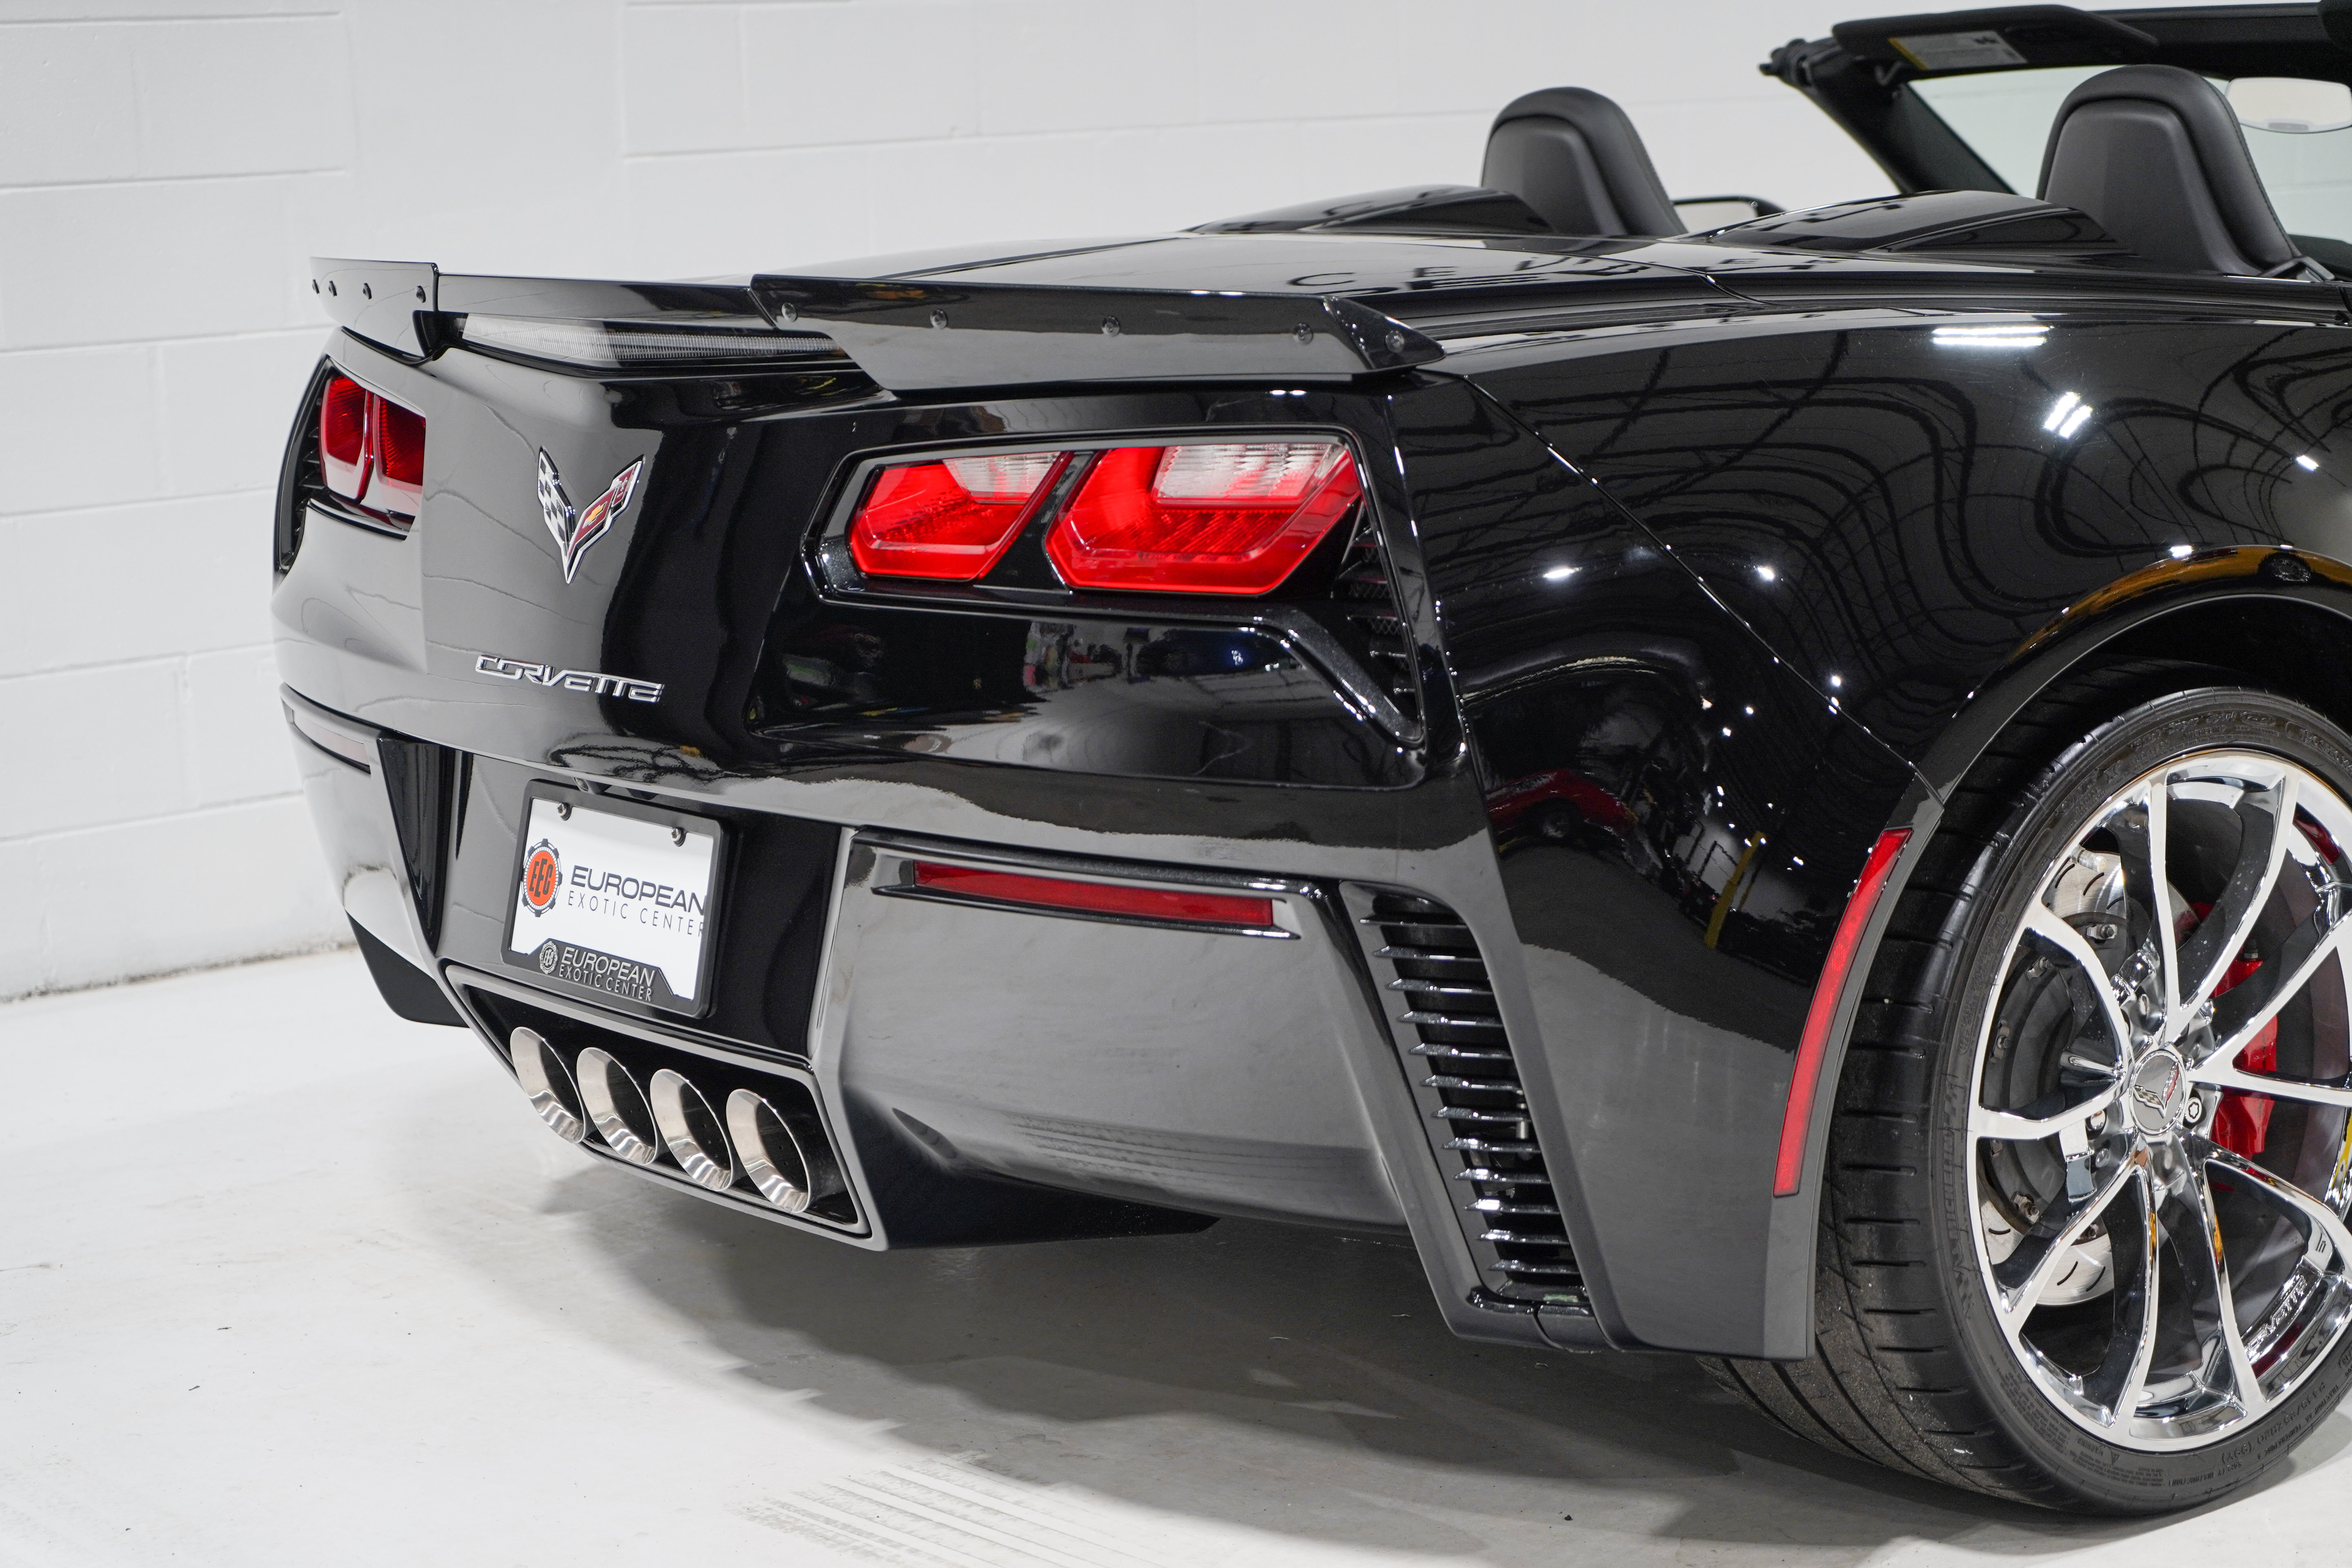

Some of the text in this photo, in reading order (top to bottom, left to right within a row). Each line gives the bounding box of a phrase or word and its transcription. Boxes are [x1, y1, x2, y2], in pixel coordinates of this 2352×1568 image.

[476, 654, 664, 702] CORVETTE
[529, 858, 553, 898] EEC
[571, 865, 707, 915] EUROPEAN
[568, 890, 628, 919] EXOTIC
[543, 949, 554, 966] EEC
[561, 947, 655, 987] EUROPEAN
[559, 964, 652, 1002] EXOTIC CENTER
[1942, 1130, 1959, 1240] MICHELIN
